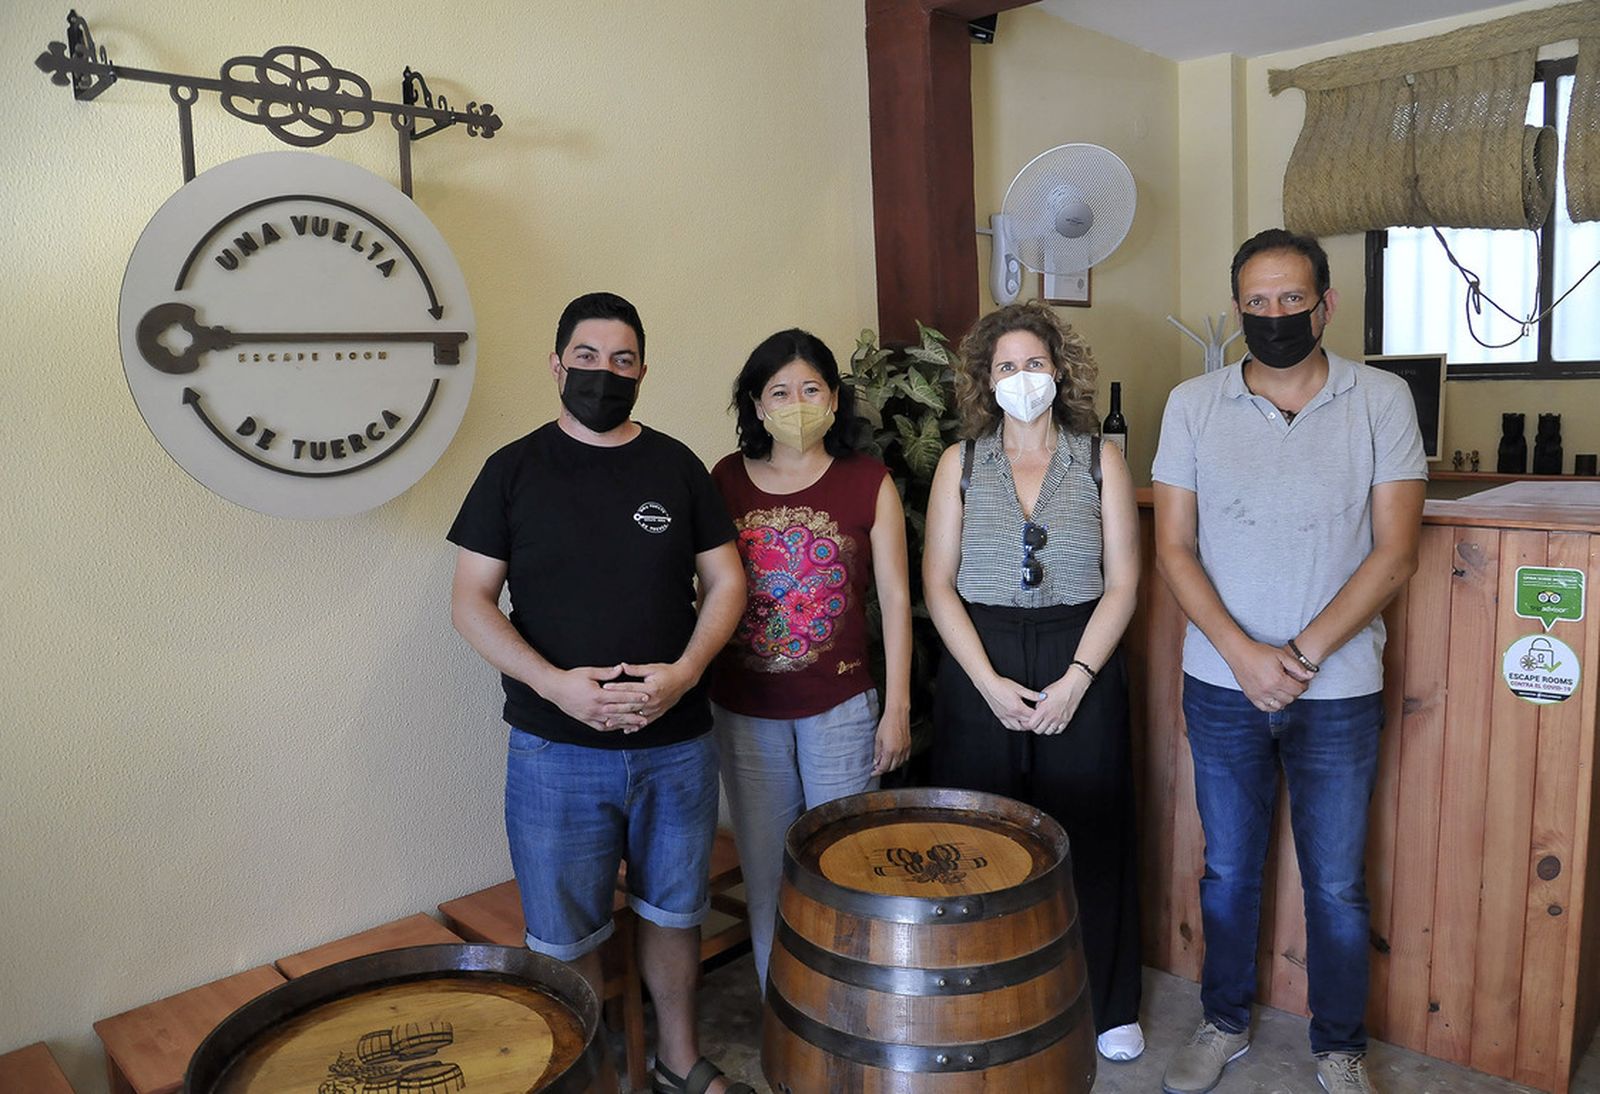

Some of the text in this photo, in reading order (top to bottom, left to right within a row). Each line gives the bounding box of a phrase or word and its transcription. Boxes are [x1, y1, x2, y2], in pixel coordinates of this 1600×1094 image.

[215, 215, 398, 278] UNA VUELTA
[238, 351, 387, 363] ESCAPE ROOM
[236, 409, 402, 461] DE TUERCA
[1508, 672, 1573, 685] ESCAPE ROOMS
[1510, 680, 1533, 688] CONTRA
